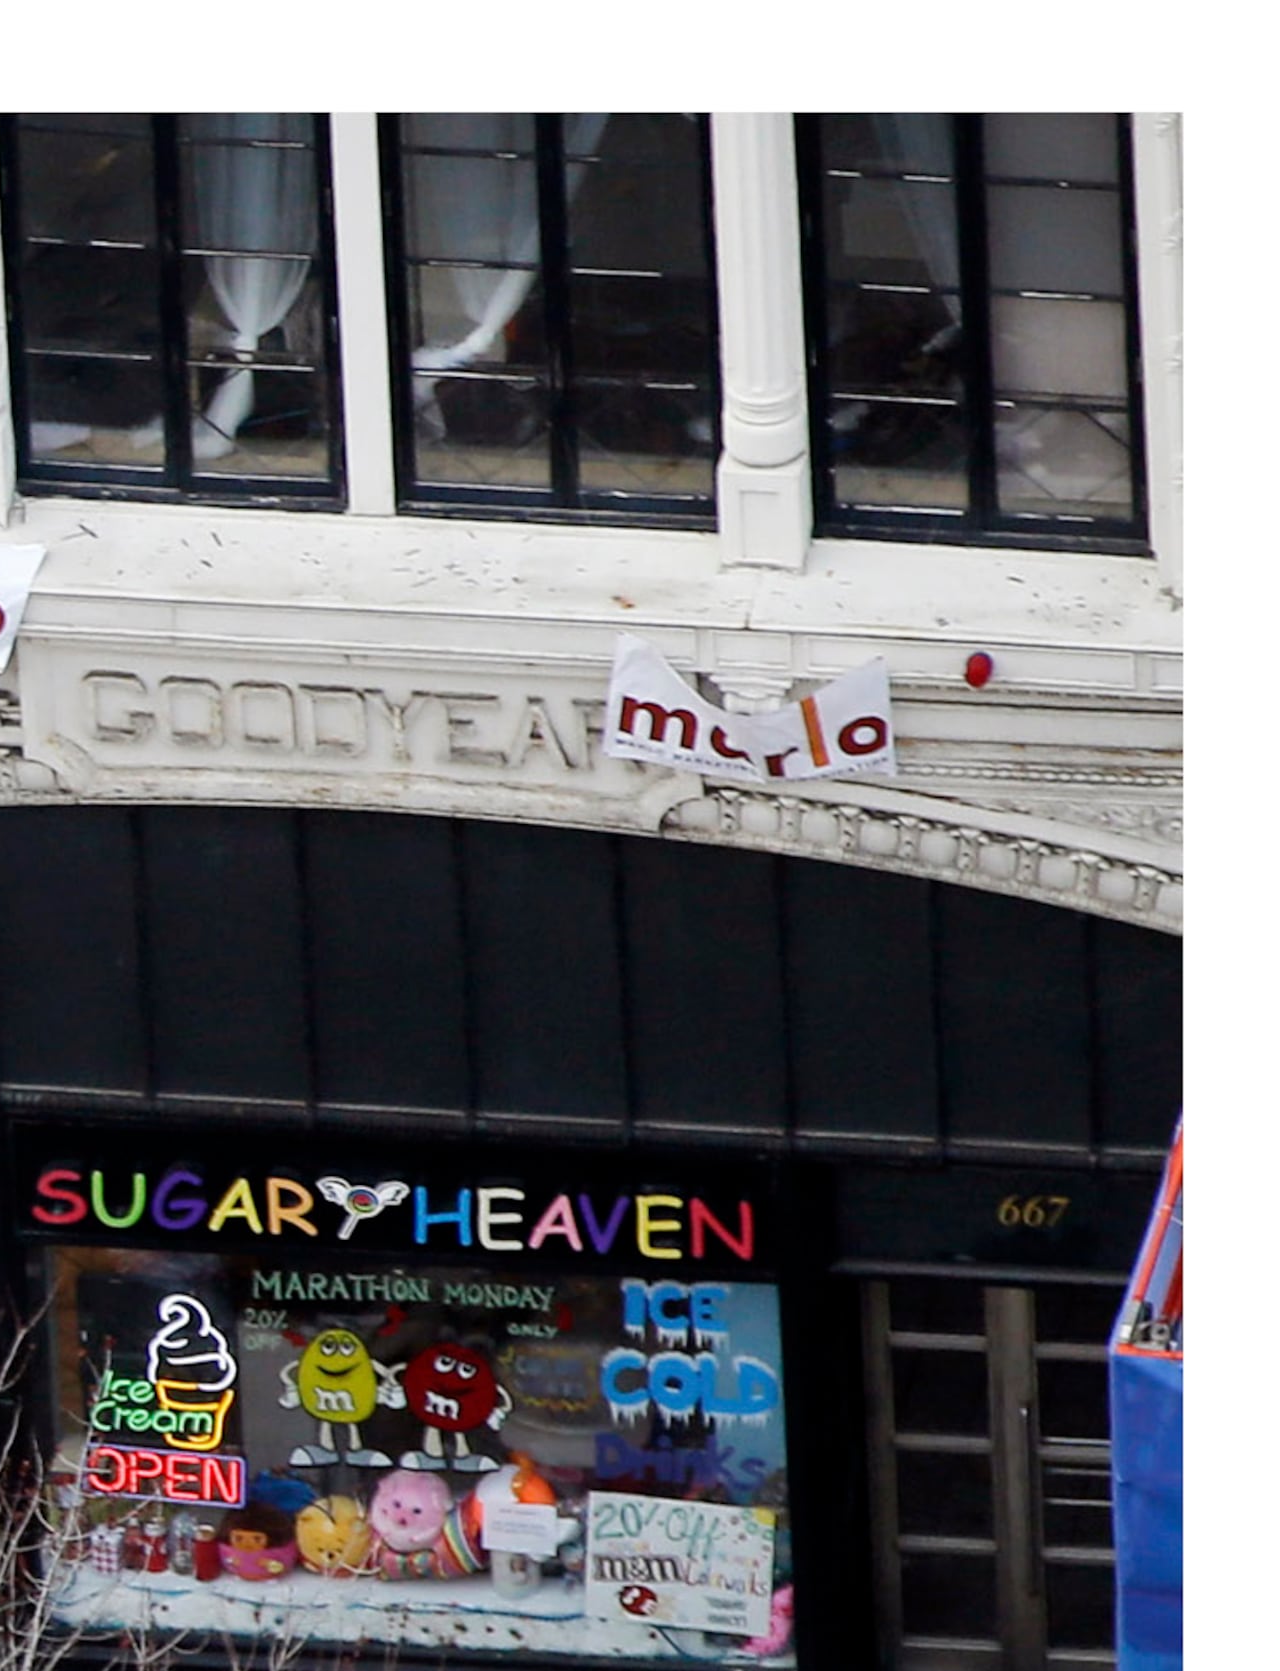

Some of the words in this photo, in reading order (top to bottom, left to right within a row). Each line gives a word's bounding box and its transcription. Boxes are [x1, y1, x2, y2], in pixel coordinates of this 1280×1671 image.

[31, 1169, 318, 1237] SUGAR
[413, 1185, 755, 1261] HEAVEN
[997, 1195, 1071, 1227] 667
[251, 1269, 432, 1302] MARATHON
[443, 1282, 556, 1312] MONDAY
[243, 1307, 289, 1329] 20%
[506, 1322, 559, 1339] ONLY
[620, 1277, 730, 1350] ICE
[243, 1333, 283, 1351] OFF
[101, 1369, 156, 1404] Ice
[313, 1388, 356, 1412] m
[600, 1347, 779, 1429] COLD
[90, 1400, 215, 1434] Cream
[423, 1390, 461, 1420] m
[88, 1446, 238, 1505] OPEN
